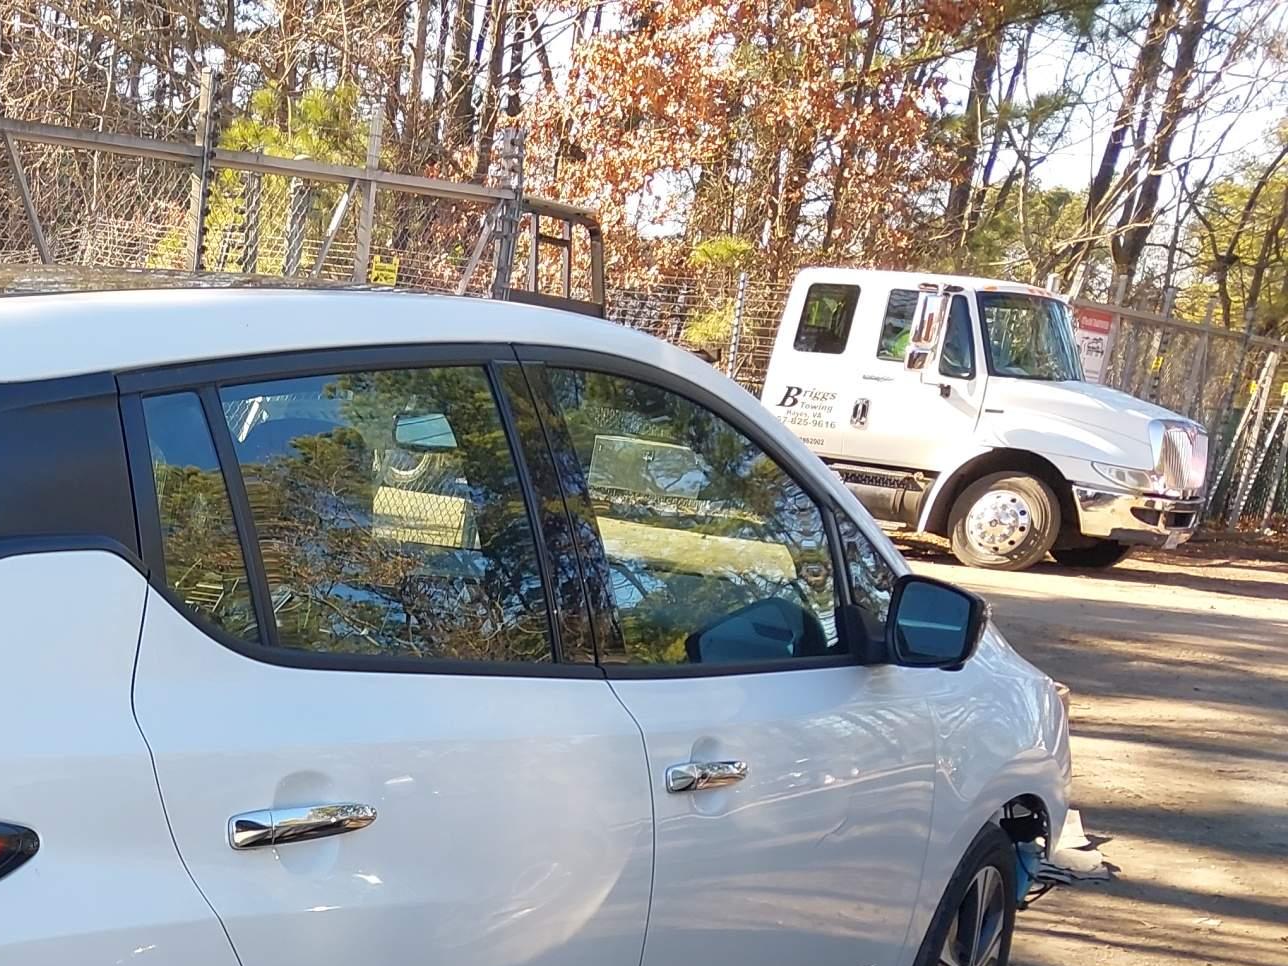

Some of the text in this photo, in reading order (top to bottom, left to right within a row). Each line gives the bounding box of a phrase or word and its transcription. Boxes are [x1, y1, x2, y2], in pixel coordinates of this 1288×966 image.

[776, 385, 838, 408] Briggs
[800, 401, 834, 413] Towing
[812, 411, 822, 419] VA
